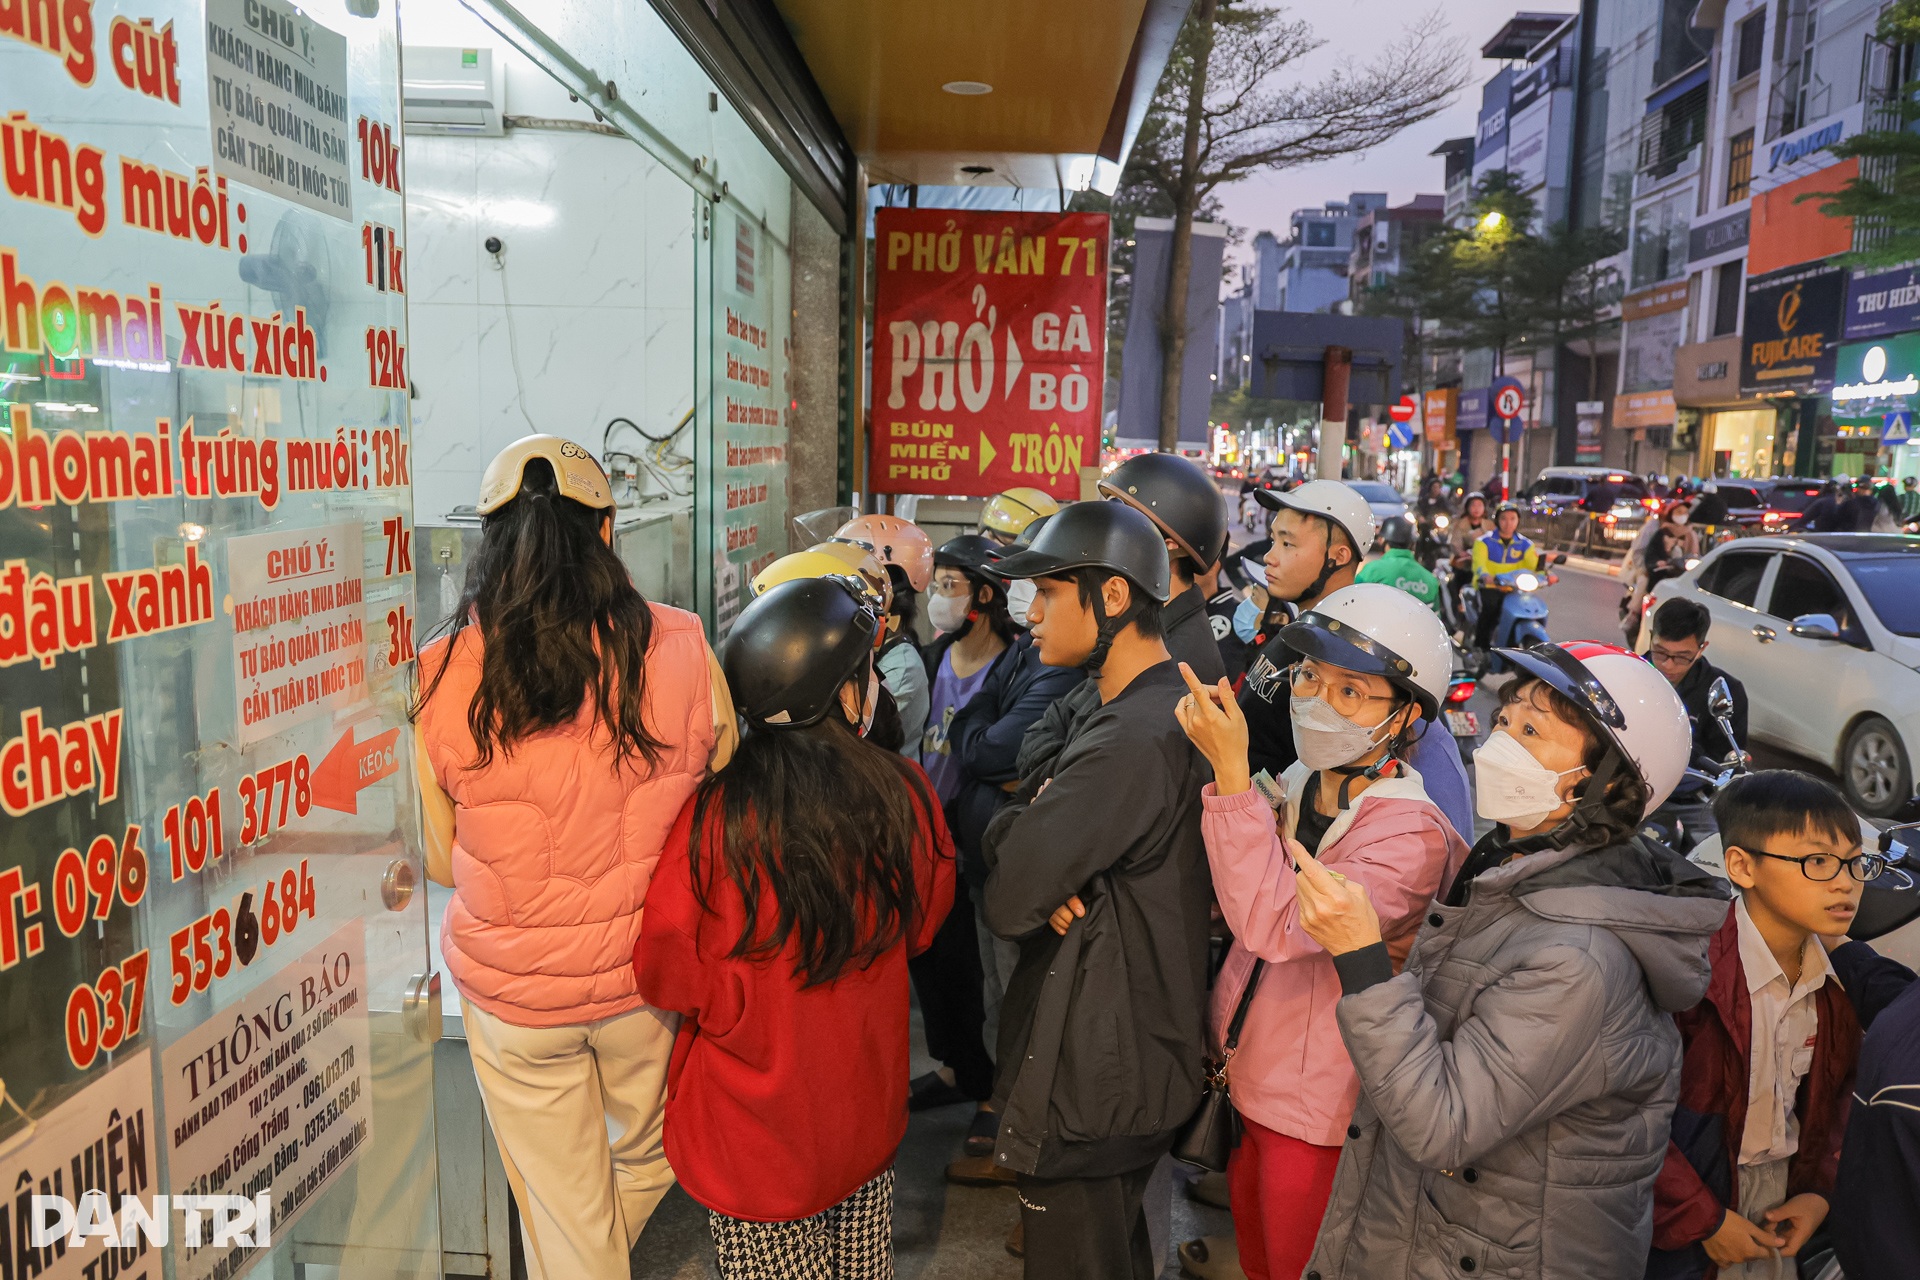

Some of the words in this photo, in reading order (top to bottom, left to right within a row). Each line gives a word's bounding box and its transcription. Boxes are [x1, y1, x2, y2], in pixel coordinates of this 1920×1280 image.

[244, 0, 295, 48] CHÚ
[111, 19, 180, 106] cút
[358, 117, 400, 193] 10k
[209, 21, 254, 75] KHÁCH
[256, 48, 293, 94] HÀNG
[294, 69, 316, 108] MUA
[316, 84, 347, 124] BÁNH
[213, 74, 233, 118] TỰ
[235, 83, 264, 127] BẢO
[267, 102, 301, 145] QUẢN
[303, 119, 321, 155] TÀI
[322, 128, 347, 166] SẢN
[217, 121, 247, 168] CẨN
[248, 143, 285, 184] THẬN
[287, 157, 300, 195] BỊ
[301, 164, 329, 200] MÓC
[329, 176, 349, 208] TÚI
[360, 223, 404, 293] 11k
[888, 219, 962, 273] PHỞ
[973, 227, 1046, 275] VÂN
[1058, 237, 1097, 276] 71
[1031, 305, 1092, 352] GÀ
[1857, 290, 1888, 314] THU
[180, 304, 244, 366] xúc
[367, 329, 406, 388] 12k
[887, 284, 997, 413] PHỞ
[1751, 333, 1823, 369] FUJICARE
[1029, 364, 1089, 412] BÒ
[181, 419, 279, 506] trứng
[371, 430, 409, 486] 13k
[890, 420, 954, 439] BÚN
[1009, 422, 1083, 486] TRỘN
[889, 462, 951, 481] PHỞ
[107, 547, 213, 637] xanh
[383, 517, 412, 576] 7k
[267, 541, 312, 579] CHÚ
[316, 538, 335, 569] Ý:
[1395, 576, 1429, 595] Grab
[235, 595, 277, 633] KHÁCH
[279, 588, 310, 622] HÀNG
[311, 585, 334, 614] MUA
[336, 576, 362, 608] BÁNH
[240, 643, 258, 683] TỰ
[260, 635, 286, 673] BẢO
[288, 626, 319, 667] QUẢN
[321, 621, 339, 653] TÀI
[341, 614, 363, 648] SẢN
[2, 714, 120, 811] chay
[387, 606, 414, 666] 3k
[243, 681, 271, 726] CẨN
[272, 677, 305, 715] THẬN
[307, 674, 319, 705] BỊ
[321, 662, 345, 697] MÓC
[347, 656, 364, 686] TÚI
[359, 748, 382, 780] KÉO
[54, 825, 146, 935] 096
[163, 790, 222, 880] 101
[239, 755, 311, 843] 3778
[67, 950, 148, 1066] 037
[182, 990, 294, 1103] THÔNG
[299, 952, 351, 1017] BÁO
[174, 1112, 200, 1149] BÁNH
[202, 1096, 220, 1127] BAO
[221, 1083, 238, 1111] THU
[275, 1041, 290, 1067] BÁN
[291, 1027, 306, 1055] QUA
[306, 1024, 312, 1042] 2
[322, 1004, 338, 1028] ĐIỆN
[249, 1092, 262, 1119] TẠI
[263, 1088, 269, 1107] 2
[210, 1153, 231, 1194] ngõ
[233, 1133, 260, 1172] Cống
[261, 1108, 289, 1147] Trắng
[274, 1143, 299, 1177] Bằng
